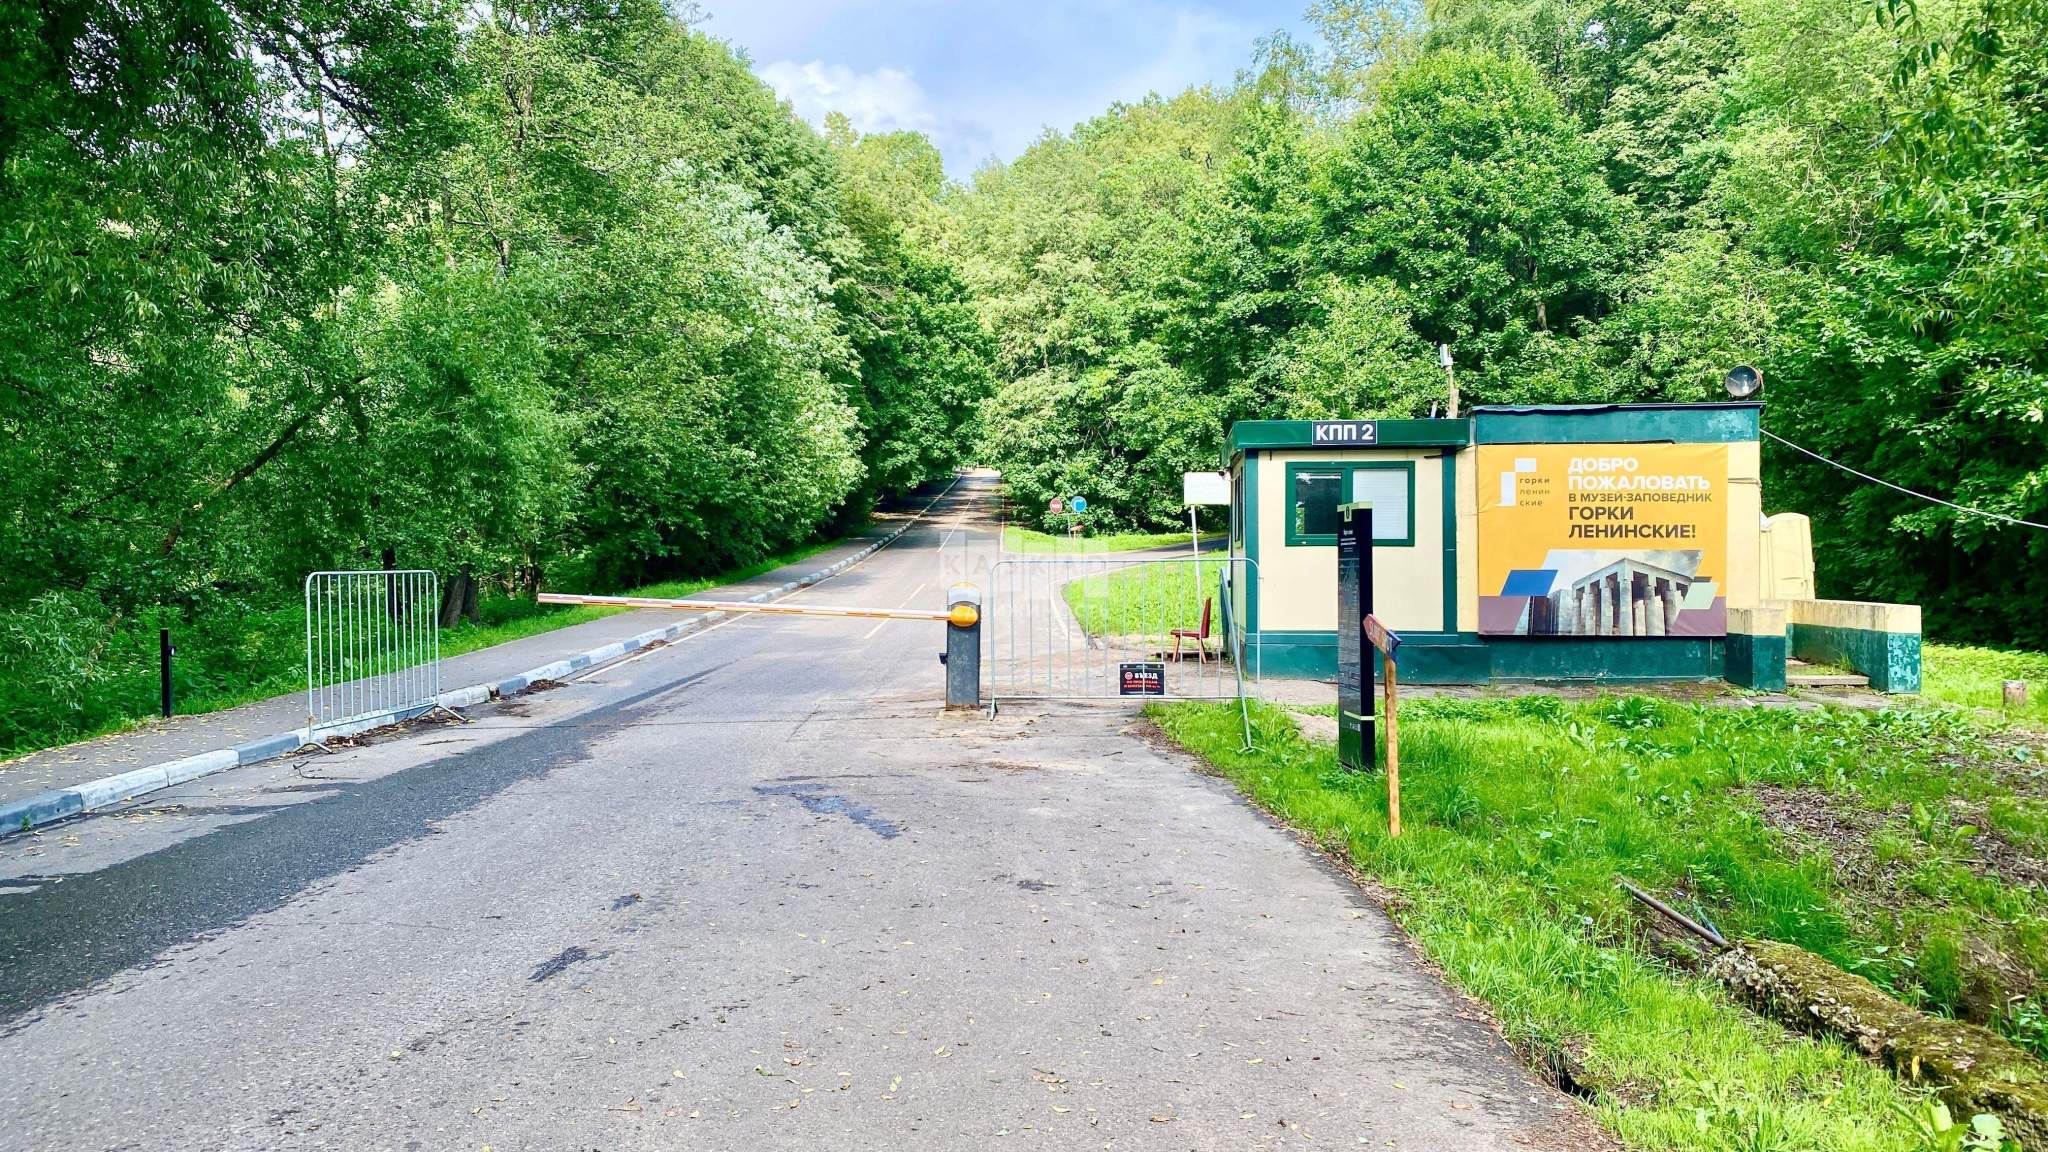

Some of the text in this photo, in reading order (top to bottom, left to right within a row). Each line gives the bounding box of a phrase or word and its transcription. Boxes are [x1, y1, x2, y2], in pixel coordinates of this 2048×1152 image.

[1316, 424, 1374, 440] КПП 2
[1568, 457, 1638, 474] ДОБРО
[1568, 475, 1711, 490] ПОЖАЛОВАТЬ
[1568, 491, 1713, 503] В МУЗЕЙ-ЗАПОВЕДНИК
[1569, 506, 1634, 520] ГОРКИ
[1568, 524, 1697, 538] ЛЕНИНСКИЕ!
